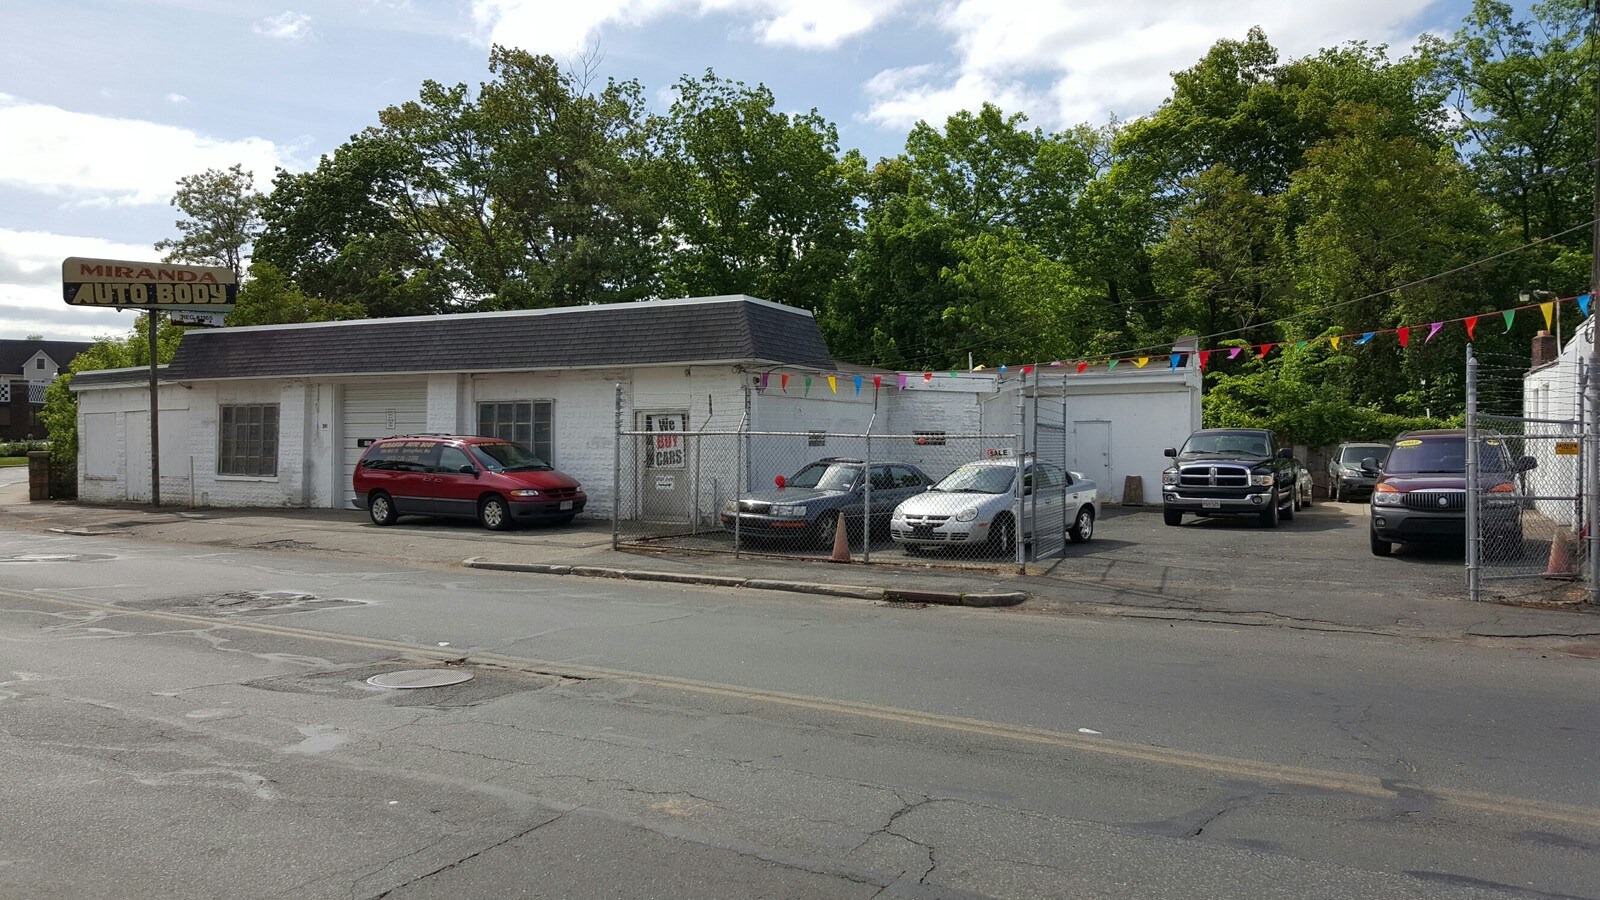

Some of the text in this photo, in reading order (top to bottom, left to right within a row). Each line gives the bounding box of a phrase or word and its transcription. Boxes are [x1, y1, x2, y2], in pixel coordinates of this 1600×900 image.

[80, 263, 218, 283] MIRANDA
[72, 282, 228, 305] AUTO BODY
[658, 417, 676, 432] We
[656, 433, 678, 450] BUY
[655, 449, 682, 467] CARS
[989, 449, 1008, 457] SALE
